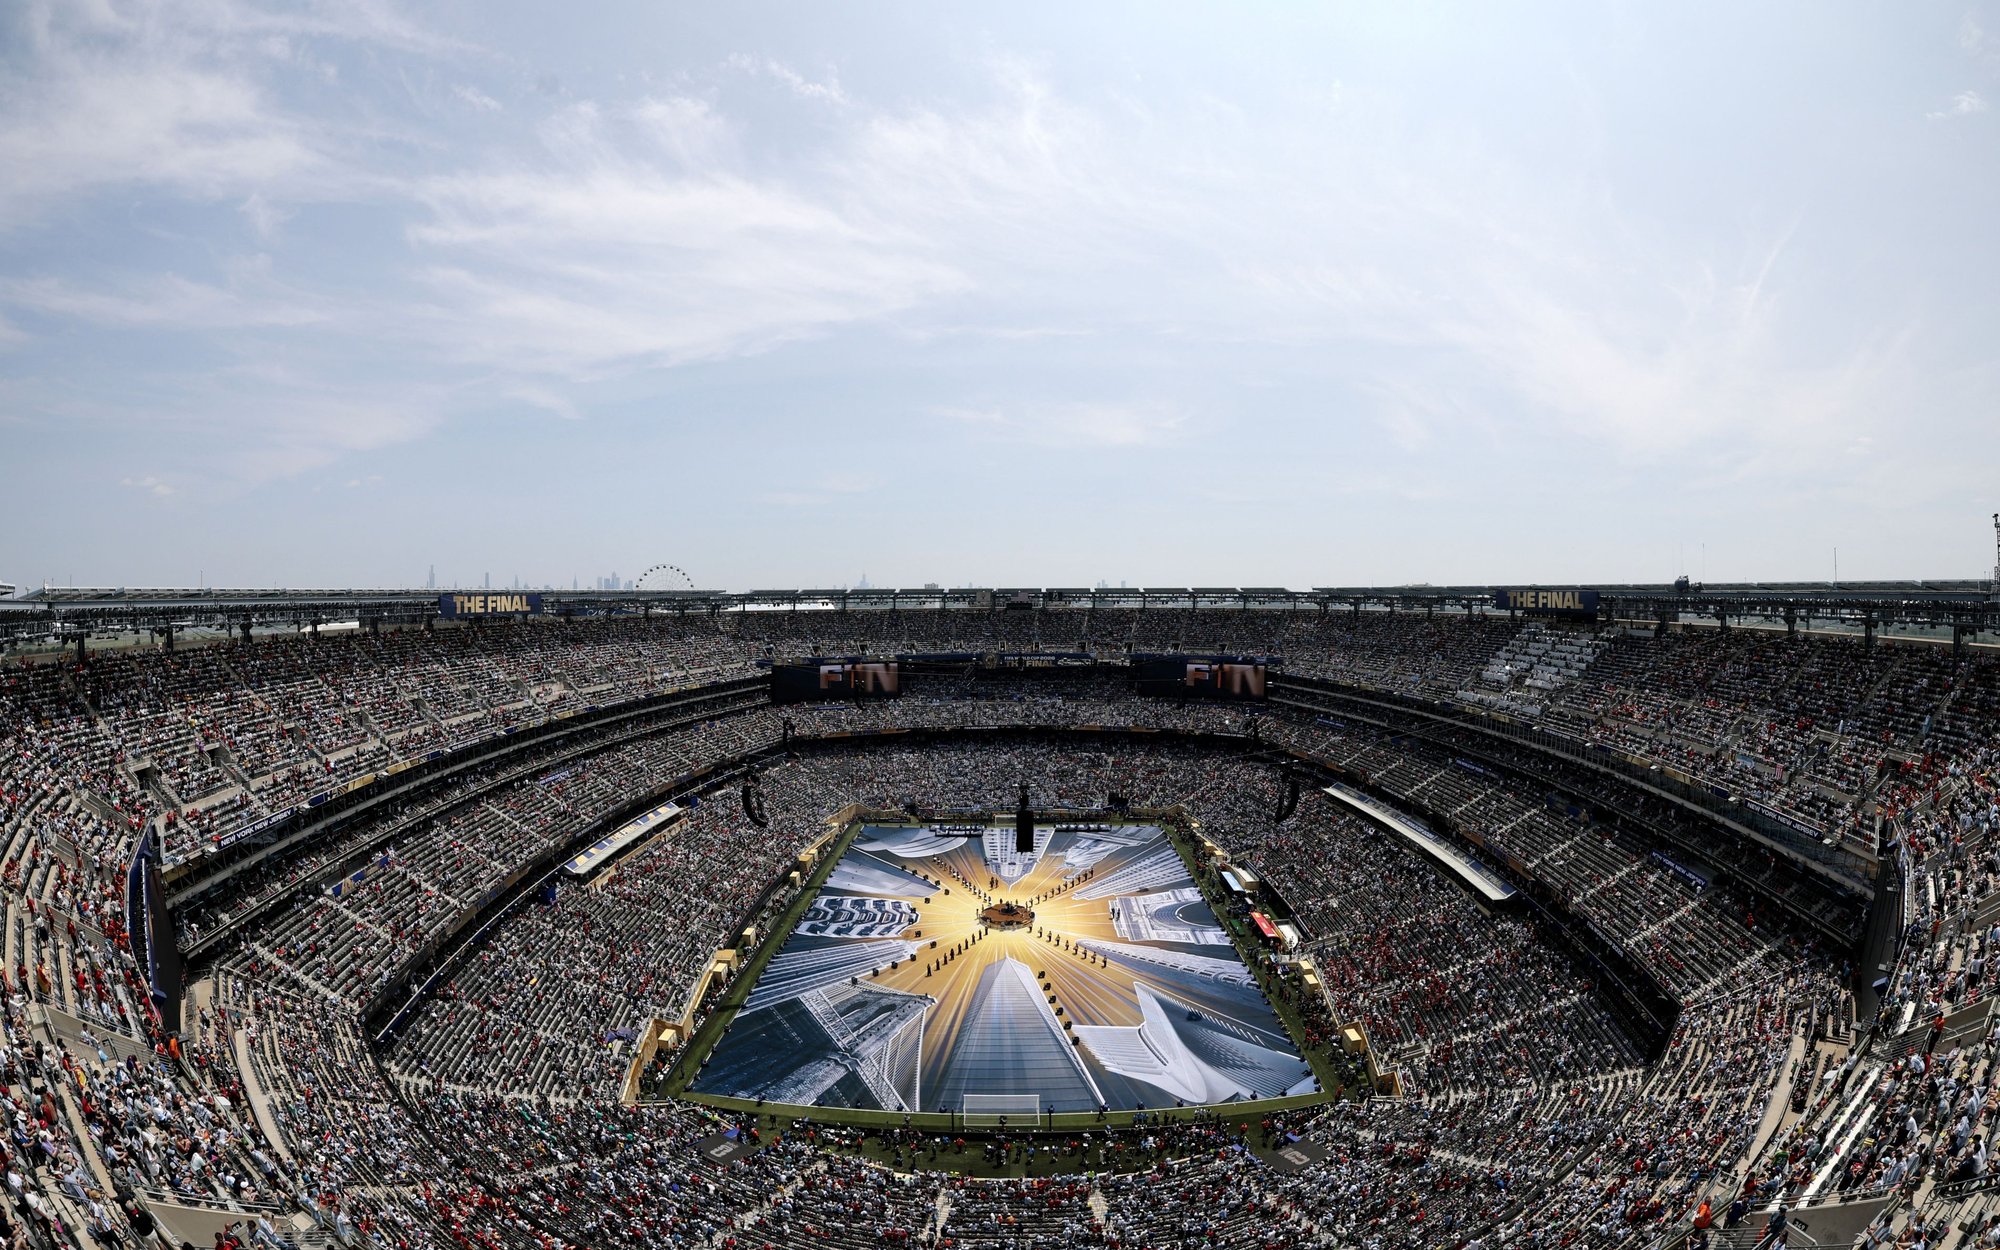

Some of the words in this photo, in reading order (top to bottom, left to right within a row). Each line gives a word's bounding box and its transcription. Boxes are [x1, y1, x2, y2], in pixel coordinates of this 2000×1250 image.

[453, 595, 485, 614] THE
[487, 595, 531, 613] FINAL
[1507, 591, 1536, 608] THE
[1538, 591, 1584, 609] FINAL
[220, 834, 236, 847] NEW
[236, 826, 255, 839] YORK
[254, 820, 269, 831] NEW
[268, 809, 292, 824] JERSEY
[1747, 802, 1761, 812] NEW
[1761, 808, 1777, 820] YORK
[1777, 815, 1793, 826] NEW
[1792, 822, 1819, 838] JERSEY
